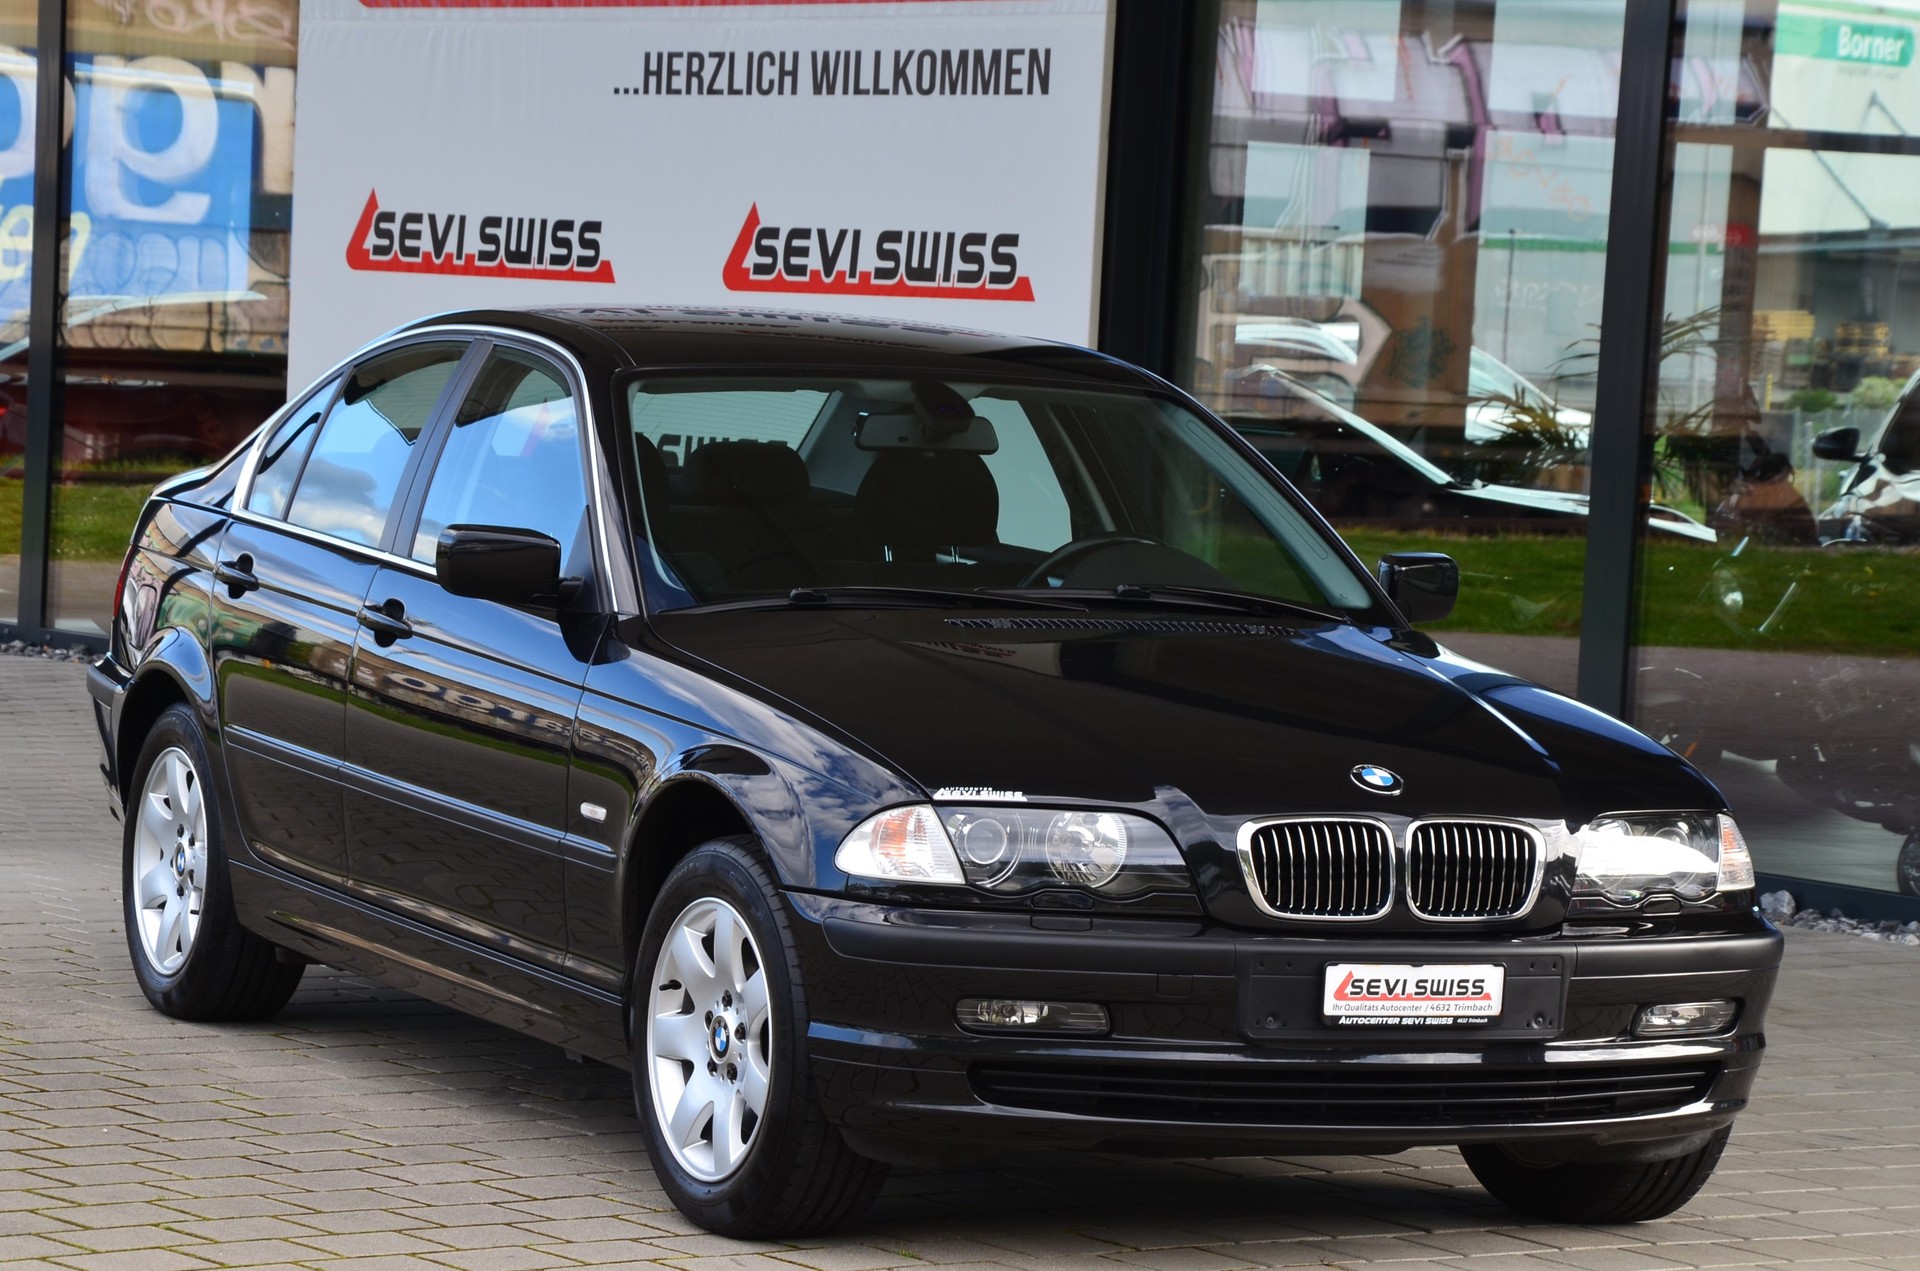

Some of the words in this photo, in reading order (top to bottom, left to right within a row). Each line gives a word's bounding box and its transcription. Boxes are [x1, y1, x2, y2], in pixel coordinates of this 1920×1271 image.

[1838, 25, 1904, 61] Borner
[811, 48, 1051, 96] WILLKOMMEN
[372, 211, 466, 261] SEVI
[477, 216, 602, 269] SWISS
[752, 226, 861, 279] SEVI
[873, 230, 1019, 285] SWISS
[980, 791, 1023, 799] SWISS
[1349, 978, 1408, 996] SEVI
[1414, 979, 1485, 996] SWISS
[1332, 1003, 1343, 1012] Ihr
[1380, 1003, 1423, 1012] Autocenter
[1454, 1003, 1493, 1012] Trimbach
[1401, 1017, 1424, 1025] SEVI
[1425, 1017, 1454, 1025] SWISS
